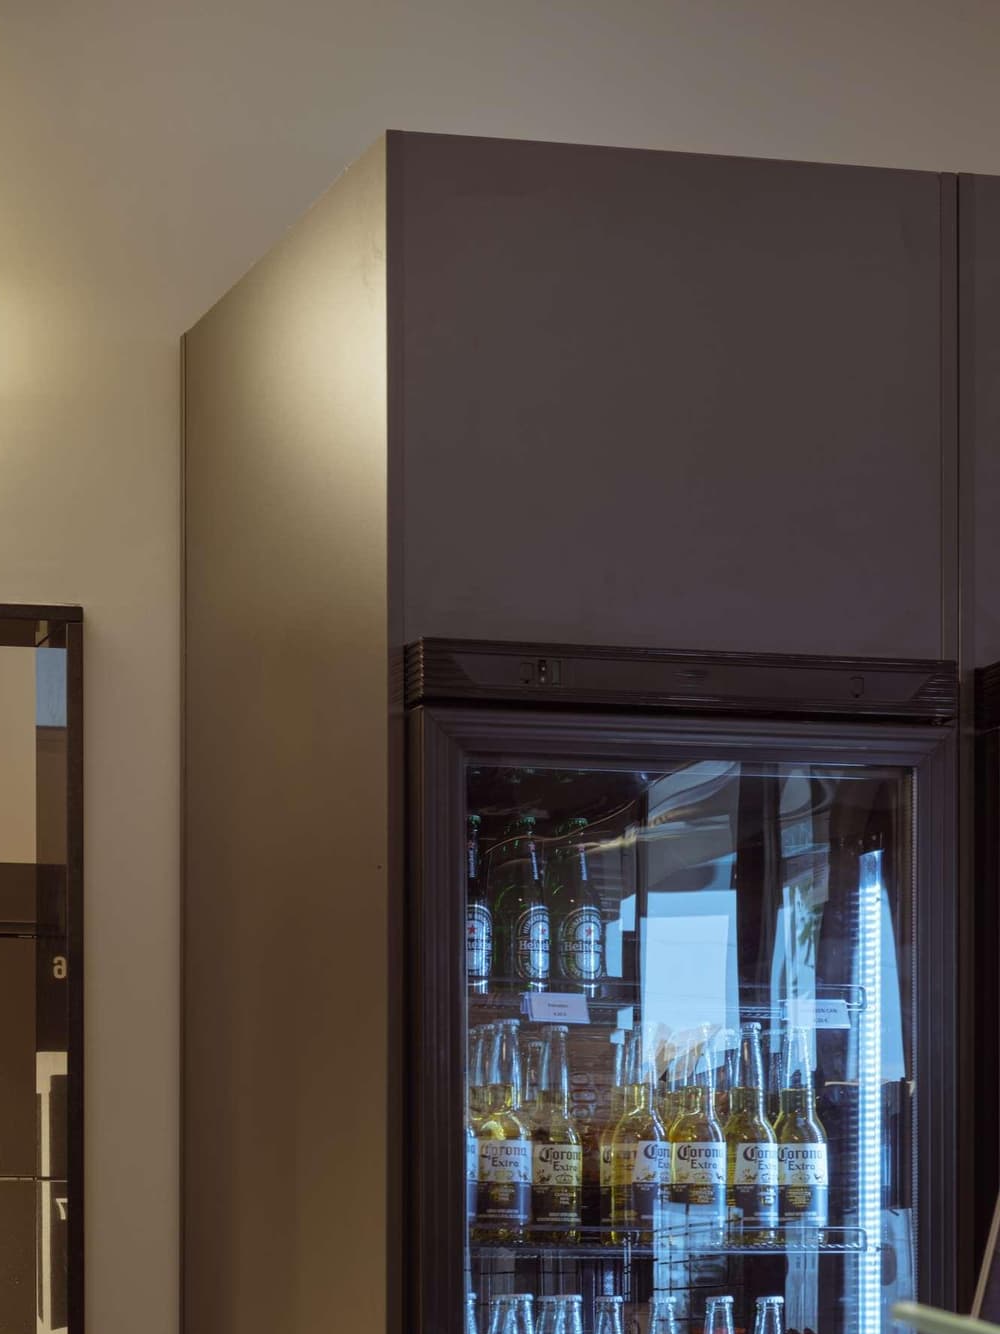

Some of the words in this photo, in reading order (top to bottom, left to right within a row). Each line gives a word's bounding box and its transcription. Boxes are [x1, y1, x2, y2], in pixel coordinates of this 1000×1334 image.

[677, 1145, 723, 1162] Coron
[490, 1156, 520, 1168] Extra
[690, 1160, 718, 1170] Extra
[787, 1160, 816, 1171] Extra
